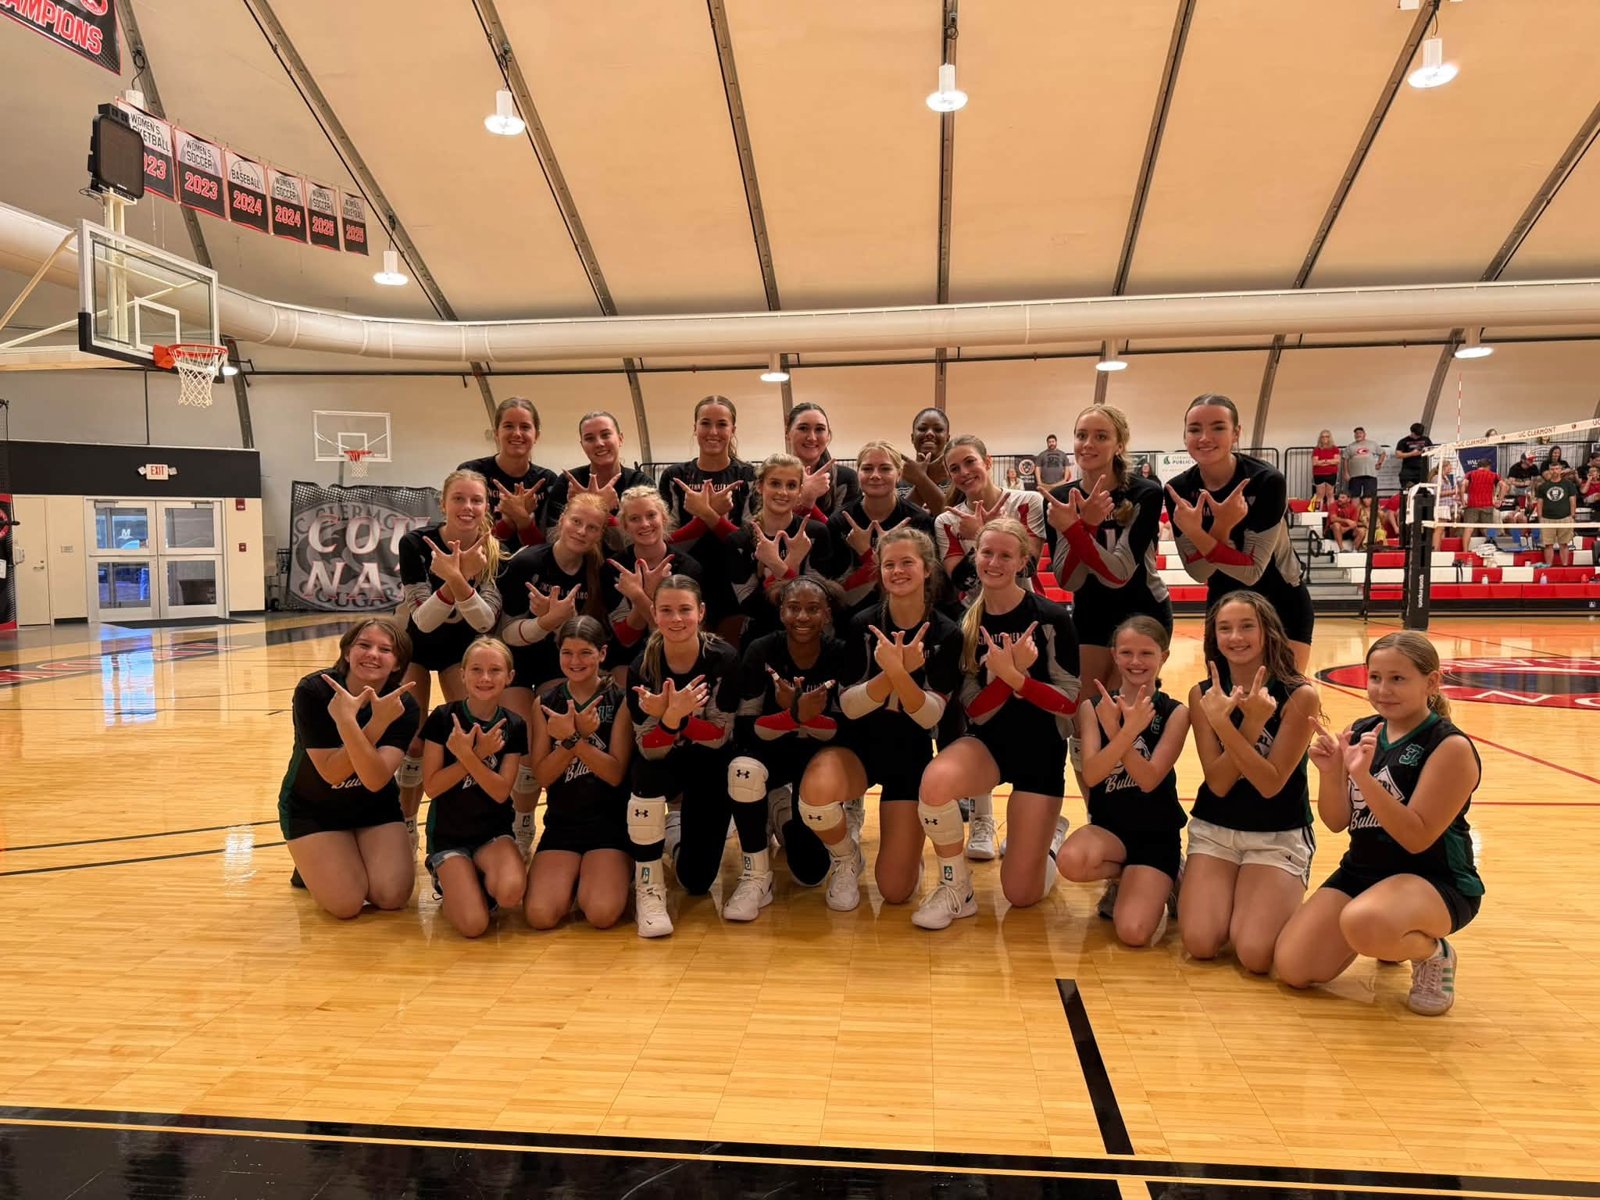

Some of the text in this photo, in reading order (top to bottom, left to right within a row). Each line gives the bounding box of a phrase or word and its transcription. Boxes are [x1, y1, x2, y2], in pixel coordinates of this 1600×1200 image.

[186, 150, 213, 170] SOCCER
[184, 171, 218, 201] 2023
[231, 168, 261, 190] BASEBALL
[233, 190, 262, 217] 2024
[275, 205, 302, 228] 2024
[151, 466, 164, 476] EXIT
